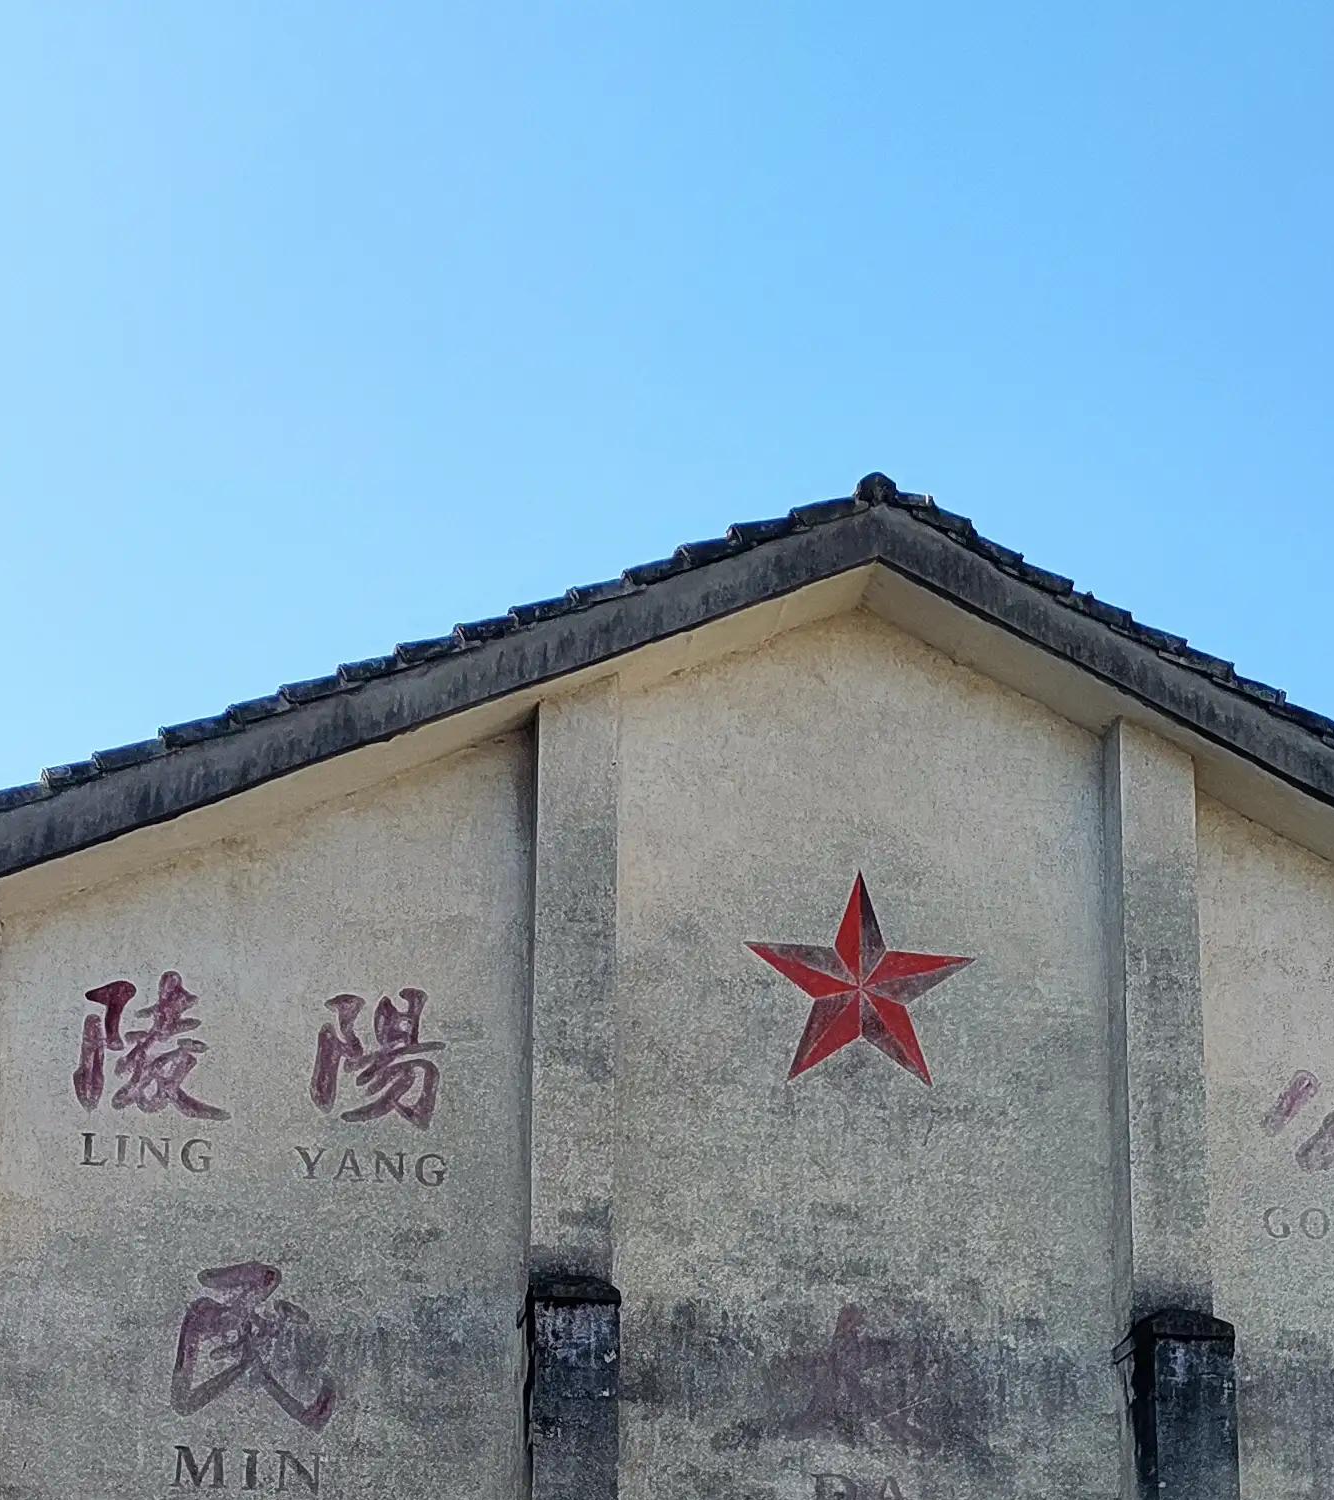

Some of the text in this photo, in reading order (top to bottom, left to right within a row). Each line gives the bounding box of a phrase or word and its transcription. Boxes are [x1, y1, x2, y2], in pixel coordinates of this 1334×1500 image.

[80, 1132, 213, 1173] LING
[295, 1146, 447, 1187] YANG
[171, 1260, 345, 1433] 民
[173, 1444, 326, 1496] MIN
